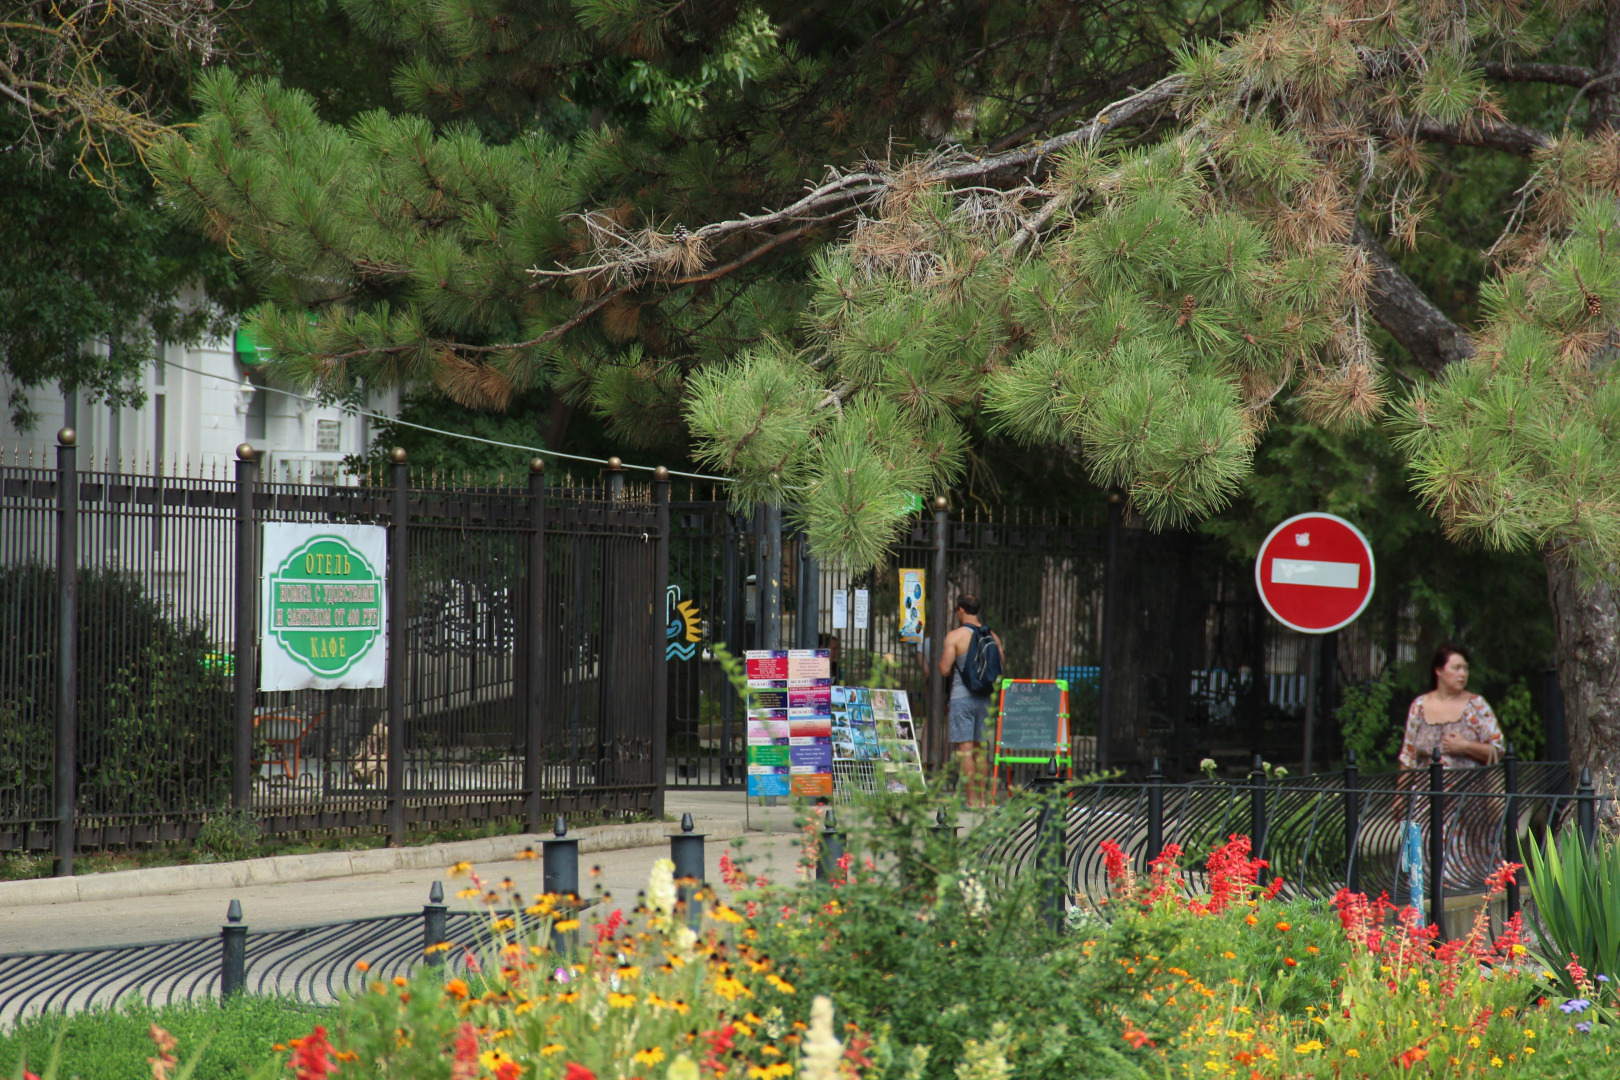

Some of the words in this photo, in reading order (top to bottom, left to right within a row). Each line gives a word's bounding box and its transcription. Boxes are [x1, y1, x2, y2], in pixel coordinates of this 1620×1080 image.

[305, 553, 351, 575] ОТЕЛЬ
[279, 585, 312, 603] НОМЕРА
[314, 585, 321, 602] С
[323, 585, 375, 605] УДОБСТВАМИ
[276, 608, 283, 626] И
[286, 608, 332, 626] ЗАВТРАКОМ
[334, 608, 346, 626] ОТ
[362, 608, 378, 627] РУБ
[310, 637, 347, 658] КАФЕ
